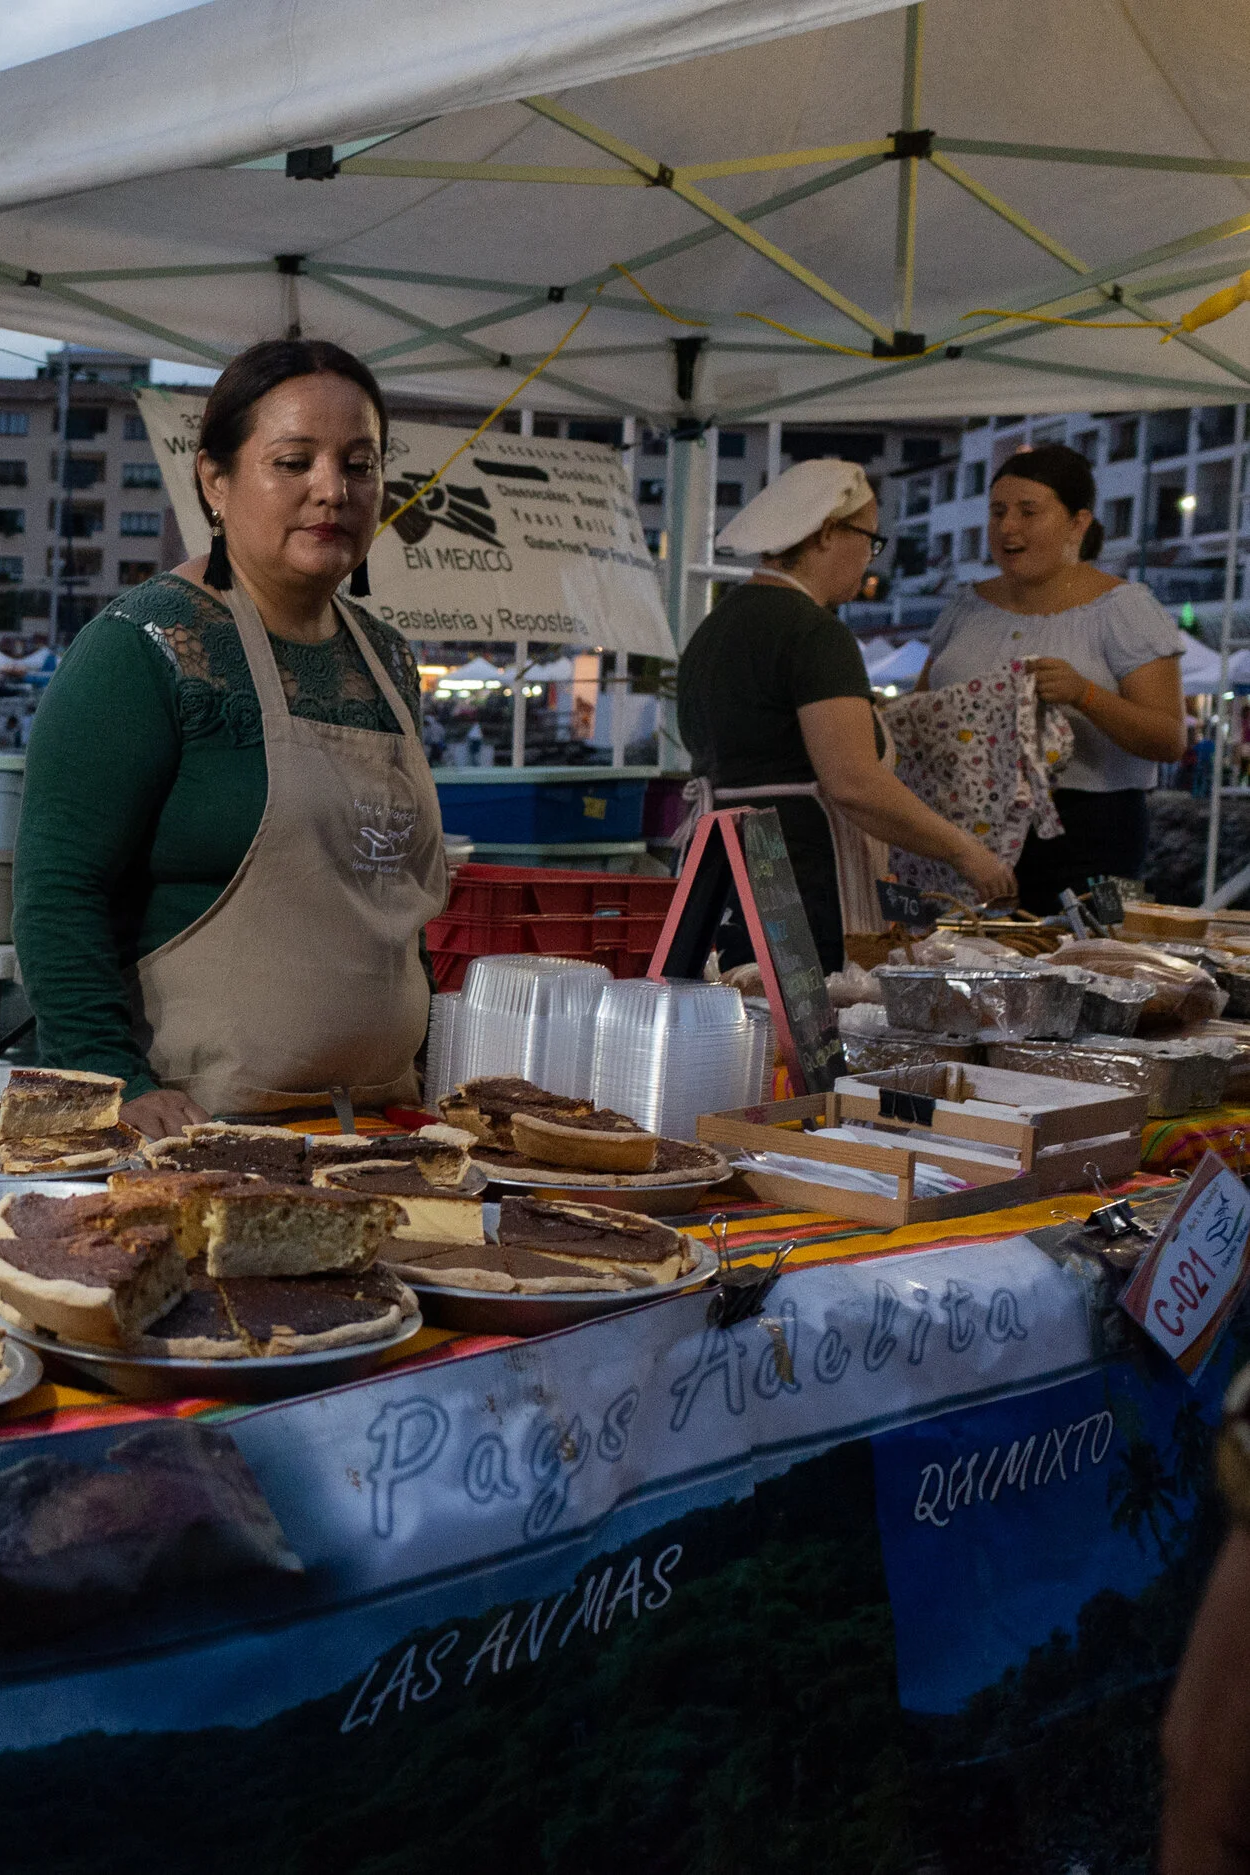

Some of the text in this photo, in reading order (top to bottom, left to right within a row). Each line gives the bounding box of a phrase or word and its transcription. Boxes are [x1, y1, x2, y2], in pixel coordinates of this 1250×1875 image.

[404, 546, 513, 573] EN MEXICO
[480, 613, 493, 637] y
[1154, 1246, 1217, 1337] C-021
[669, 1278, 1028, 1433] Adelita
[913, 1410, 1114, 1528] QUIMIXTO
[339, 1543, 684, 1735] LAS ANMAS
